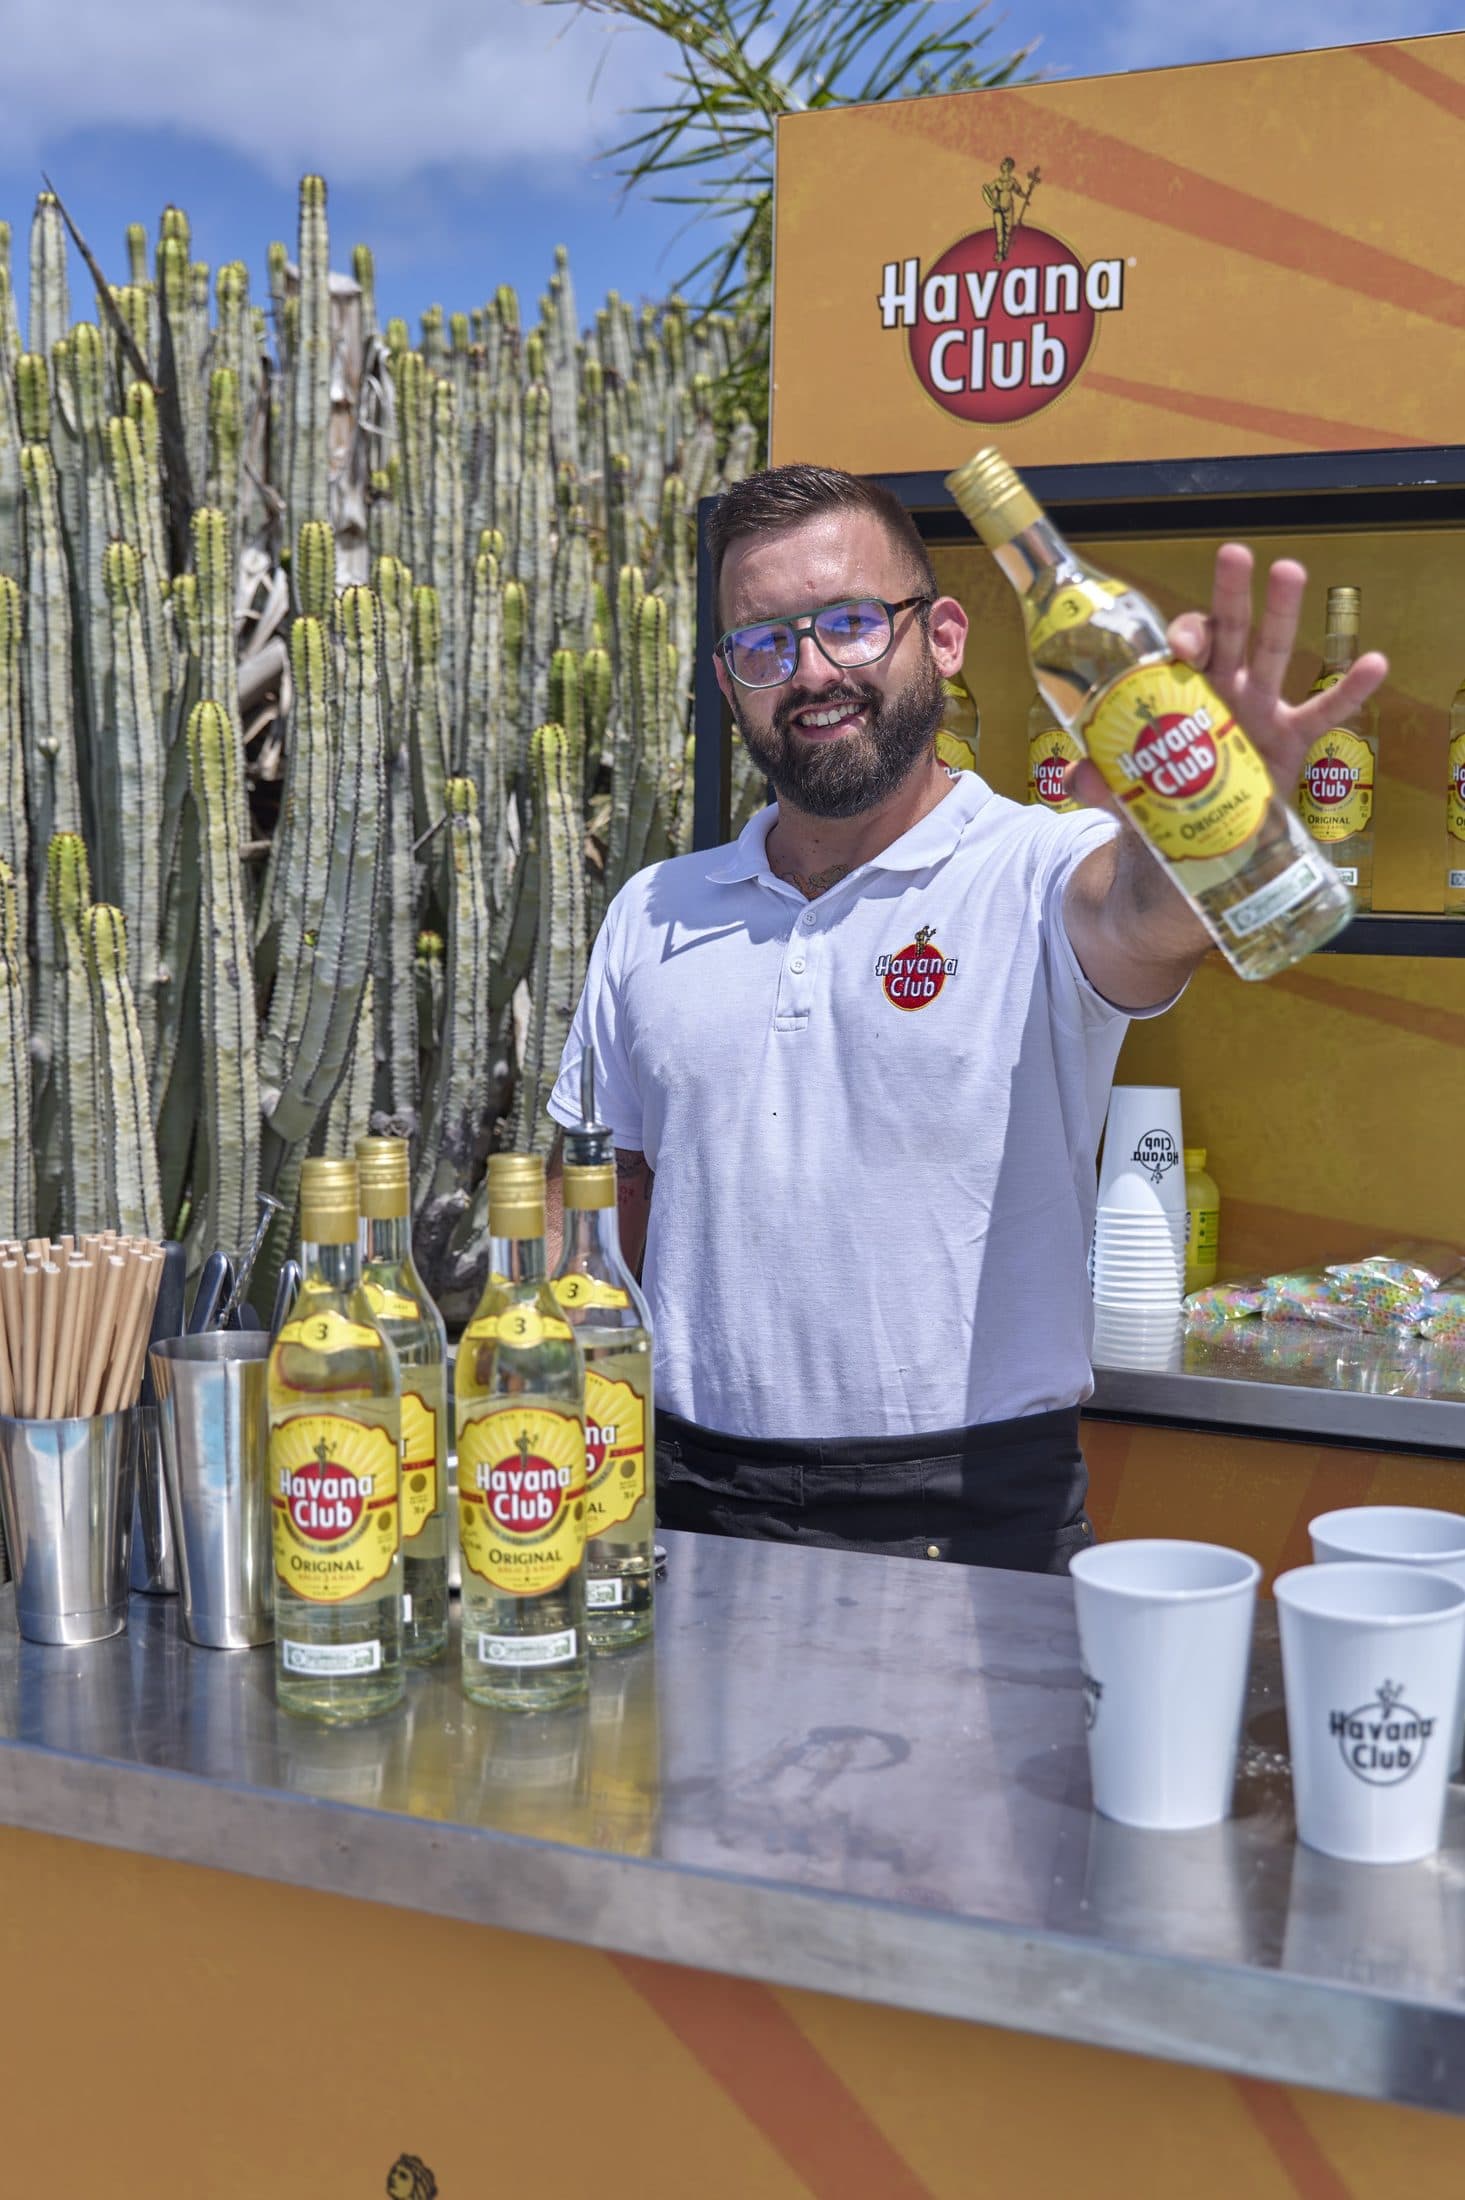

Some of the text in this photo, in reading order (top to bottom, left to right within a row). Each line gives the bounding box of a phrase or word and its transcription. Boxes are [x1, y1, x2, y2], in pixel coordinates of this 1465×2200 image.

[877, 257, 1125, 330] Havana
[928, 320, 1068, 394] Club
[1062, 600, 1079, 617] 3
[1116, 707, 1214, 781] Havana
[1032, 762, 1064, 779] Hava
[1151, 744, 1215, 796] Club
[1304, 763, 1360, 782] Havana
[1311, 780, 1346, 798] Club
[1179, 789, 1253, 841] ORIGINAL
[1307, 814, 1351, 825] ORIGINAL
[875, 954, 958, 976] Havana
[890, 976, 936, 997] Club
[1145, 1137, 1171, 1150] Club
[1132, 1151, 1179, 1165] Havana
[567, 1283, 579, 1299] 3
[315, 1321, 328, 1341] 3
[514, 1317, 527, 1335] 3
[279, 1468, 374, 1499] Havana
[476, 1462, 571, 1492] Havana
[293, 1499, 353, 1529] Club
[493, 1492, 553, 1521] Club
[290, 1554, 365, 1573] ORIGINAL
[488, 1548, 564, 1565] ORIGINAL
[1328, 1709, 1433, 1740] Havana
[1352, 1744, 1412, 1769] Club
